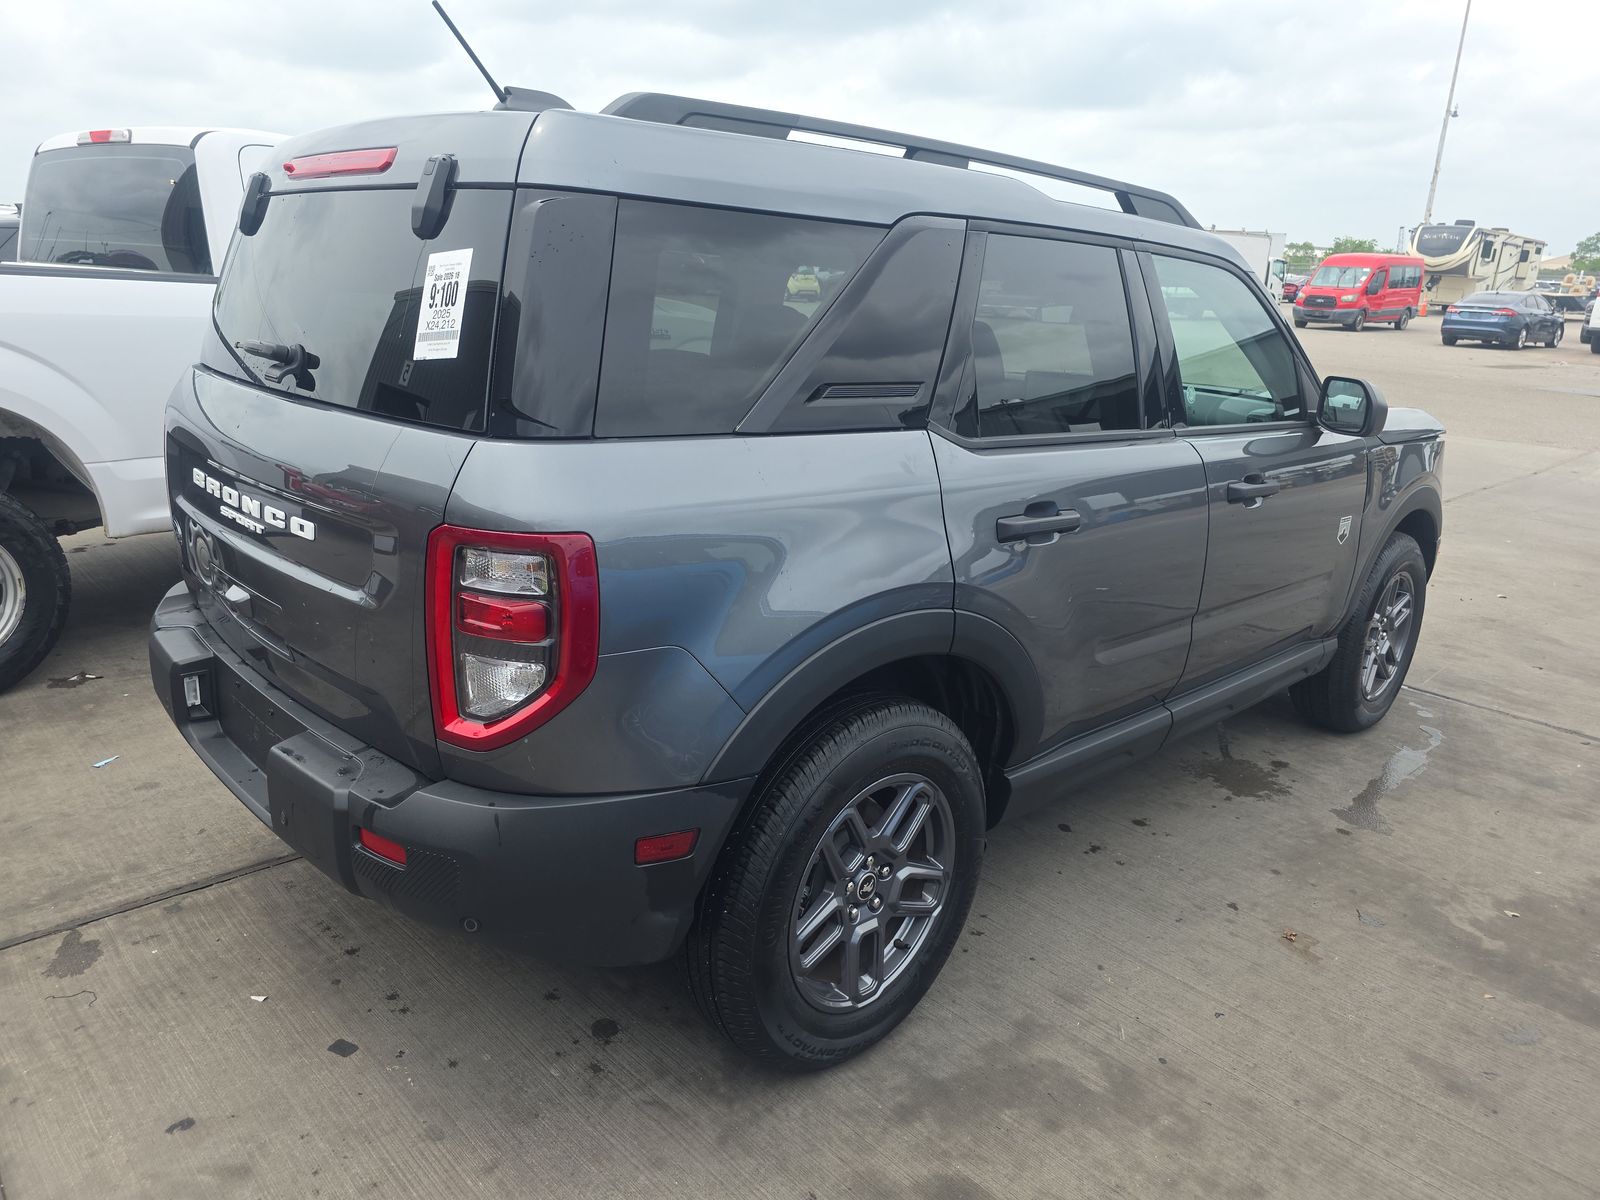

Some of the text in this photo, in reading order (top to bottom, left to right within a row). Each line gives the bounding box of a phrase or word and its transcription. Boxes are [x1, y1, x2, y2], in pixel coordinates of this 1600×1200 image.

[434, 273, 444, 281] Sale
[429, 280, 459, 309] 9:100
[433, 309, 451, 319] 2025
[192, 467, 317, 541] BRONCO
[220, 505, 266, 534] SPORT
